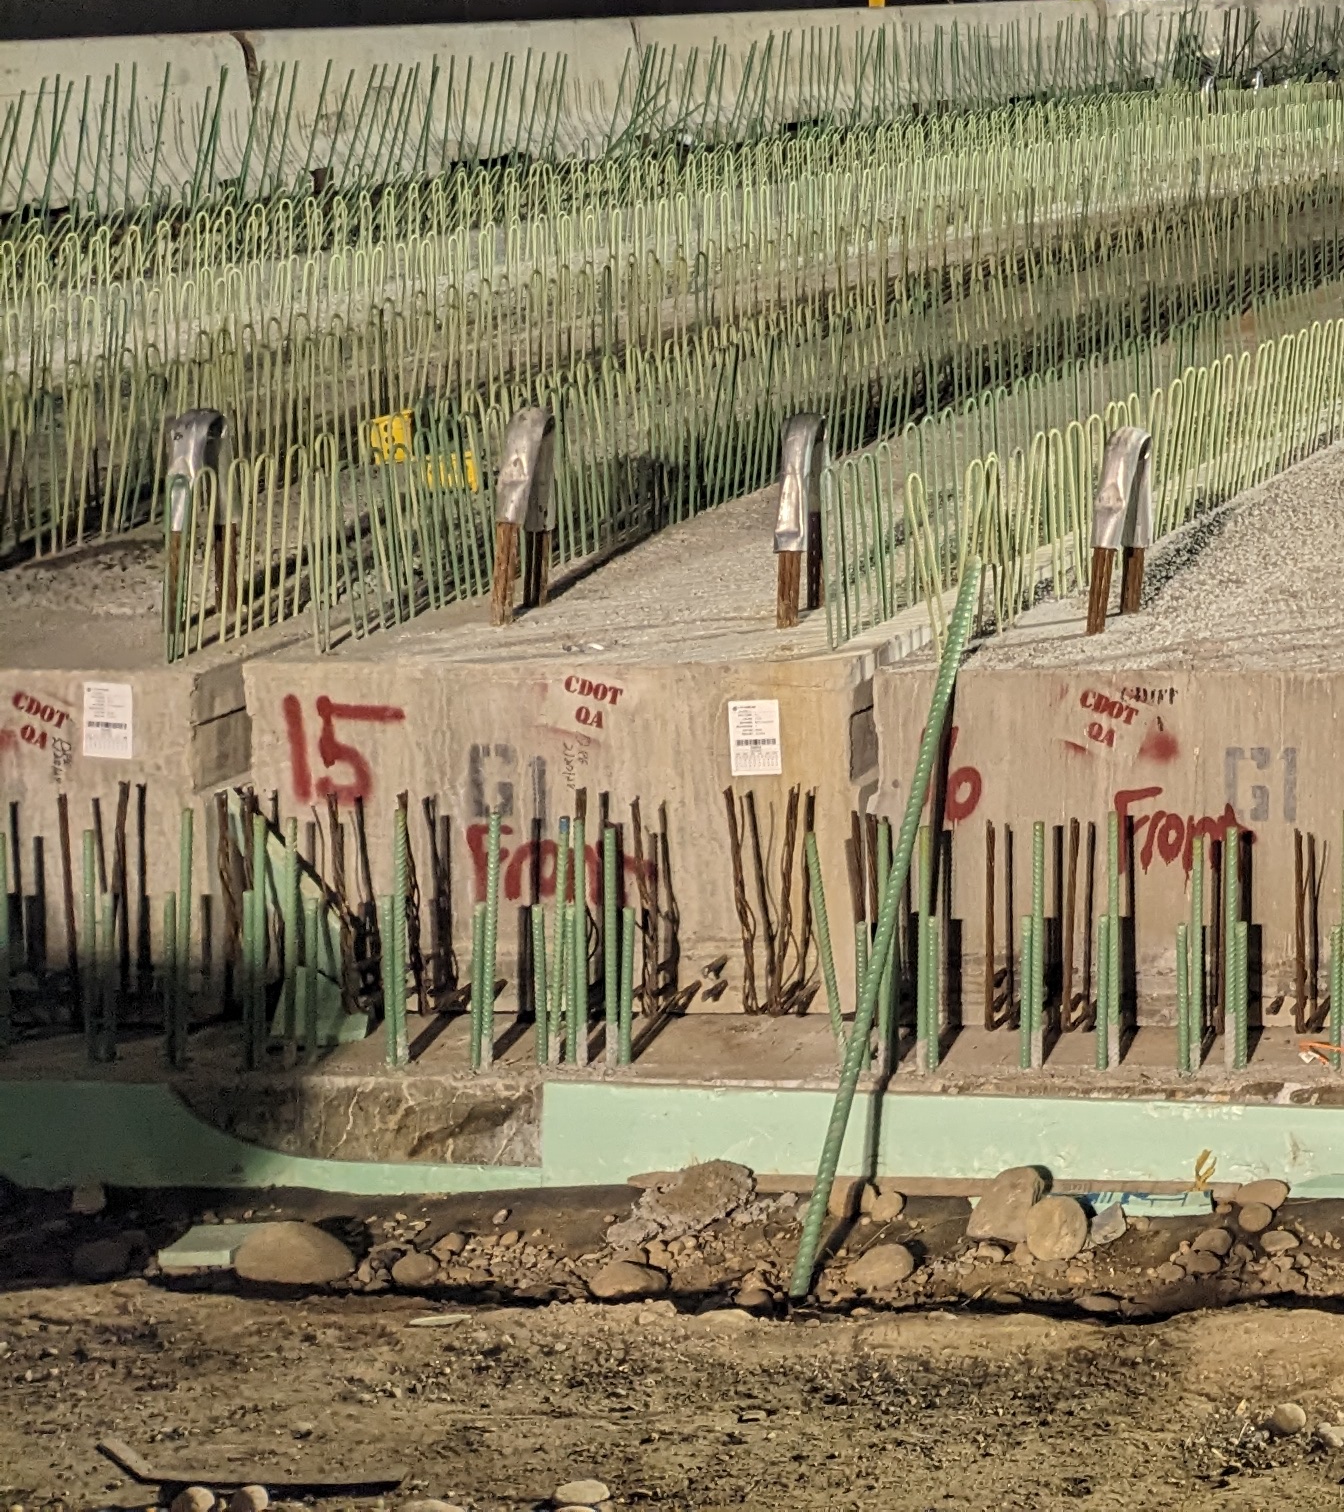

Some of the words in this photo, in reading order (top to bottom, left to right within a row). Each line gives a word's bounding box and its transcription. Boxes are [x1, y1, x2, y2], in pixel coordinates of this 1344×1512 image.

[564, 675, 623, 705] CDOT
[12, 691, 70, 729] CDOT
[575, 705, 604, 729] QA
[1080, 690, 1139, 725] CDOT
[21, 724, 48, 750] QA
[281, 693, 407, 805] 15
[1087, 721, 1116, 748] QA
[1224, 746, 1298, 823] G1
